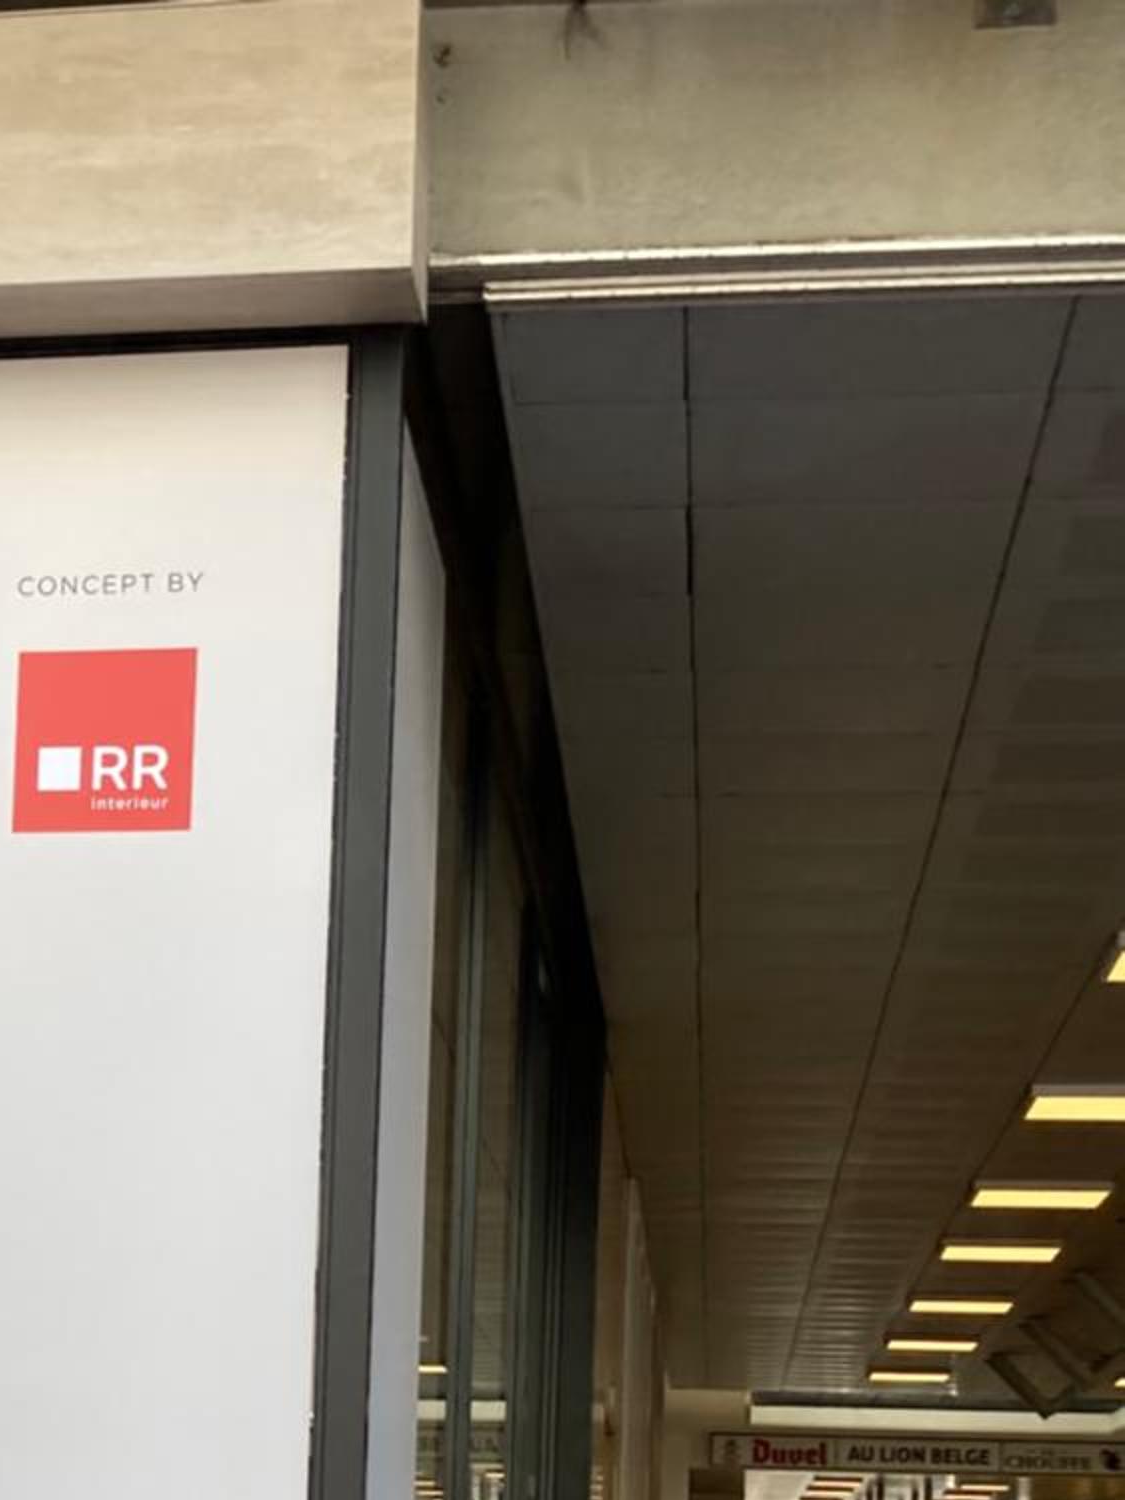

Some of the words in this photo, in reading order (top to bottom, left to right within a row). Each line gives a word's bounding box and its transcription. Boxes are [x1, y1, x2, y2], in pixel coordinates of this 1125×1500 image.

[17, 573, 155, 597] CONCEPT
[167, 572, 204, 593] BY
[91, 744, 169, 791] RR
[752, 1439, 827, 1465] Duvel
[847, 1446, 875, 1462] AU
[880, 1446, 926, 1464] LION
[930, 1448, 990, 1466] BELGE
